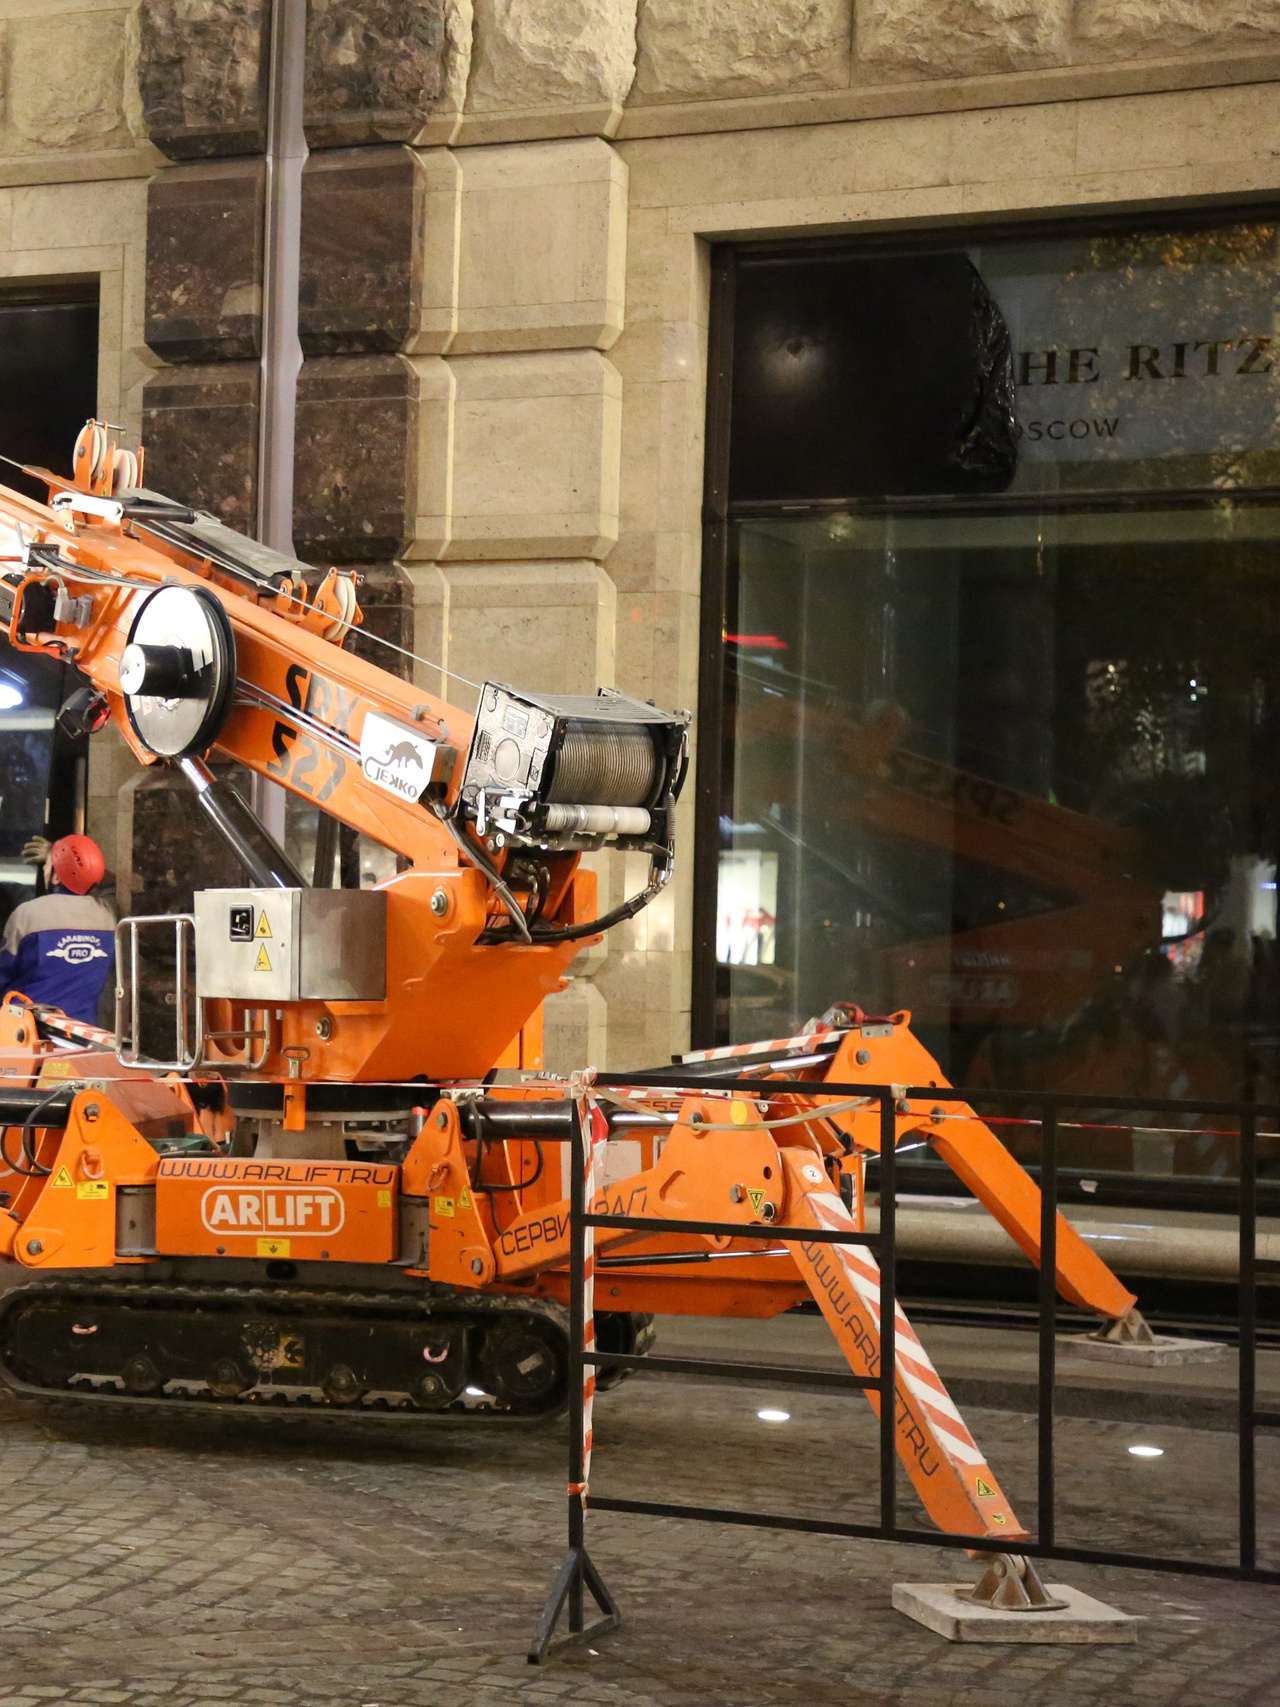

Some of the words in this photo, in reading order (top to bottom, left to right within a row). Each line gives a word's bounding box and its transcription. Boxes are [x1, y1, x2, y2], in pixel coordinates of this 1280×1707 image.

[266, 720, 346, 802] 527
[71, 949, 89, 957] PRO
[160, 1163, 393, 1185] WWW.ARLIFT.RU
